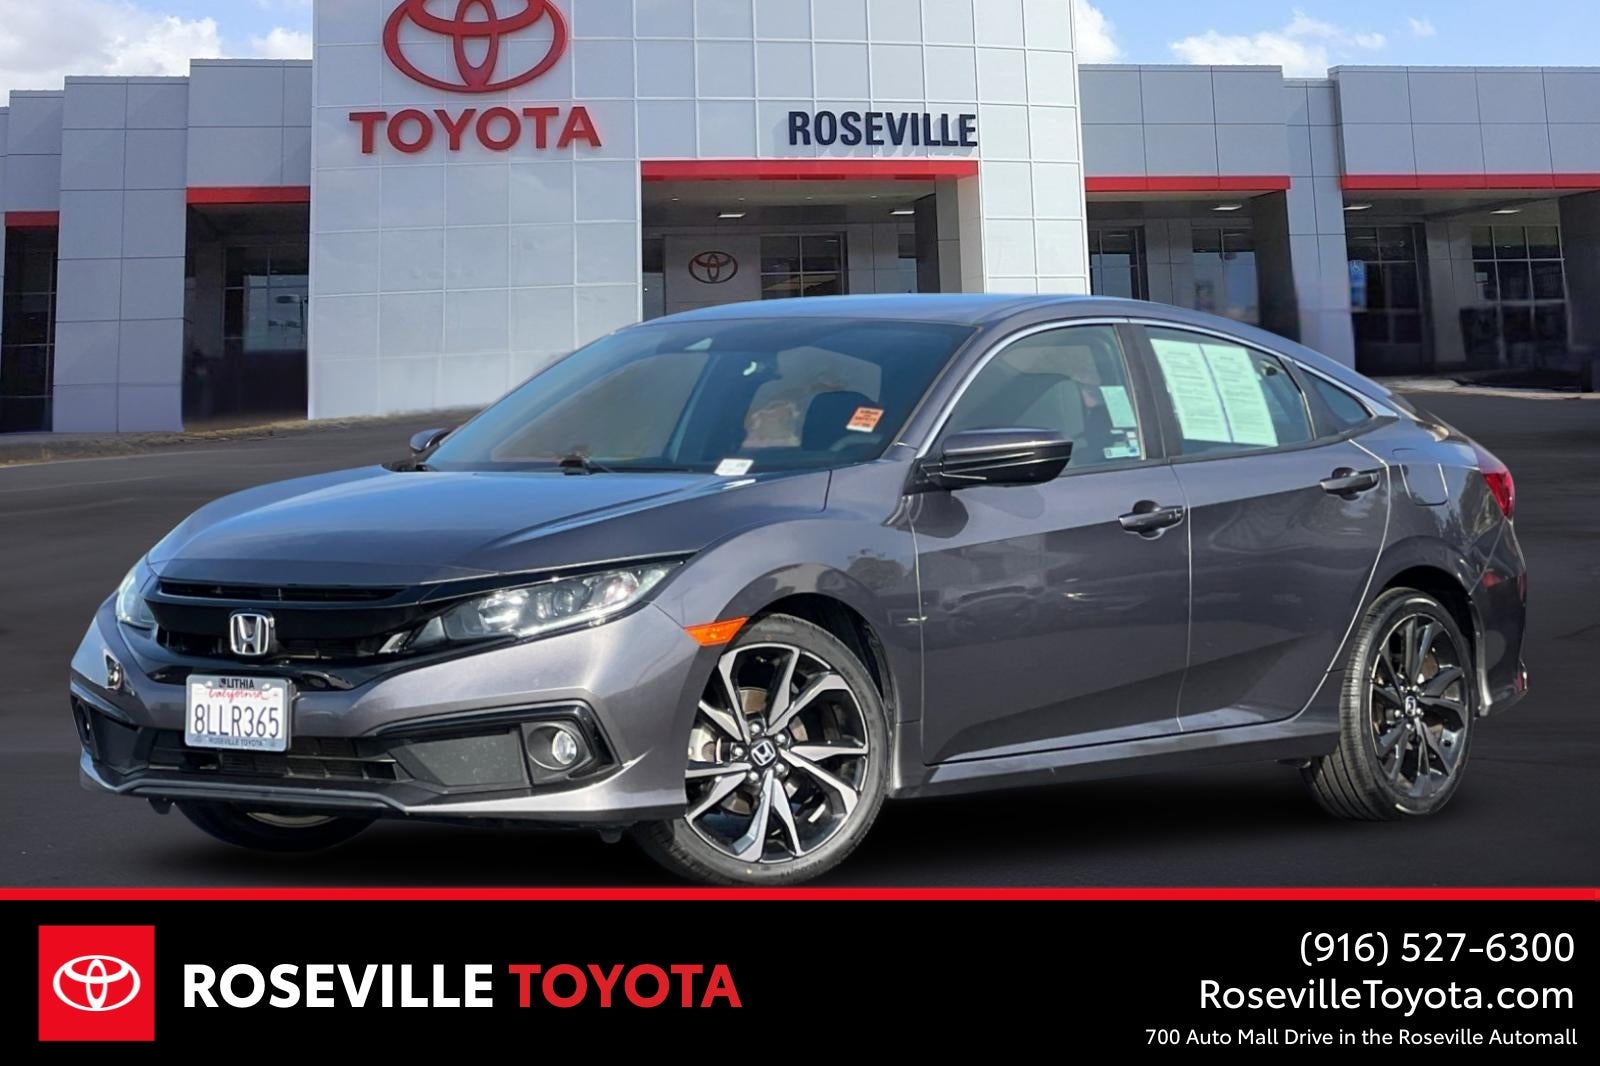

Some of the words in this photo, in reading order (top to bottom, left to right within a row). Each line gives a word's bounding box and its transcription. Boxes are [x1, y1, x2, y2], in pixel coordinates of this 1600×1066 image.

[350, 106, 602, 154] TOYOTA
[788, 110, 978, 148] ROSEVILLE
[226, 678, 255, 689] LITHIA
[194, 703, 280, 739] 8LLR365
